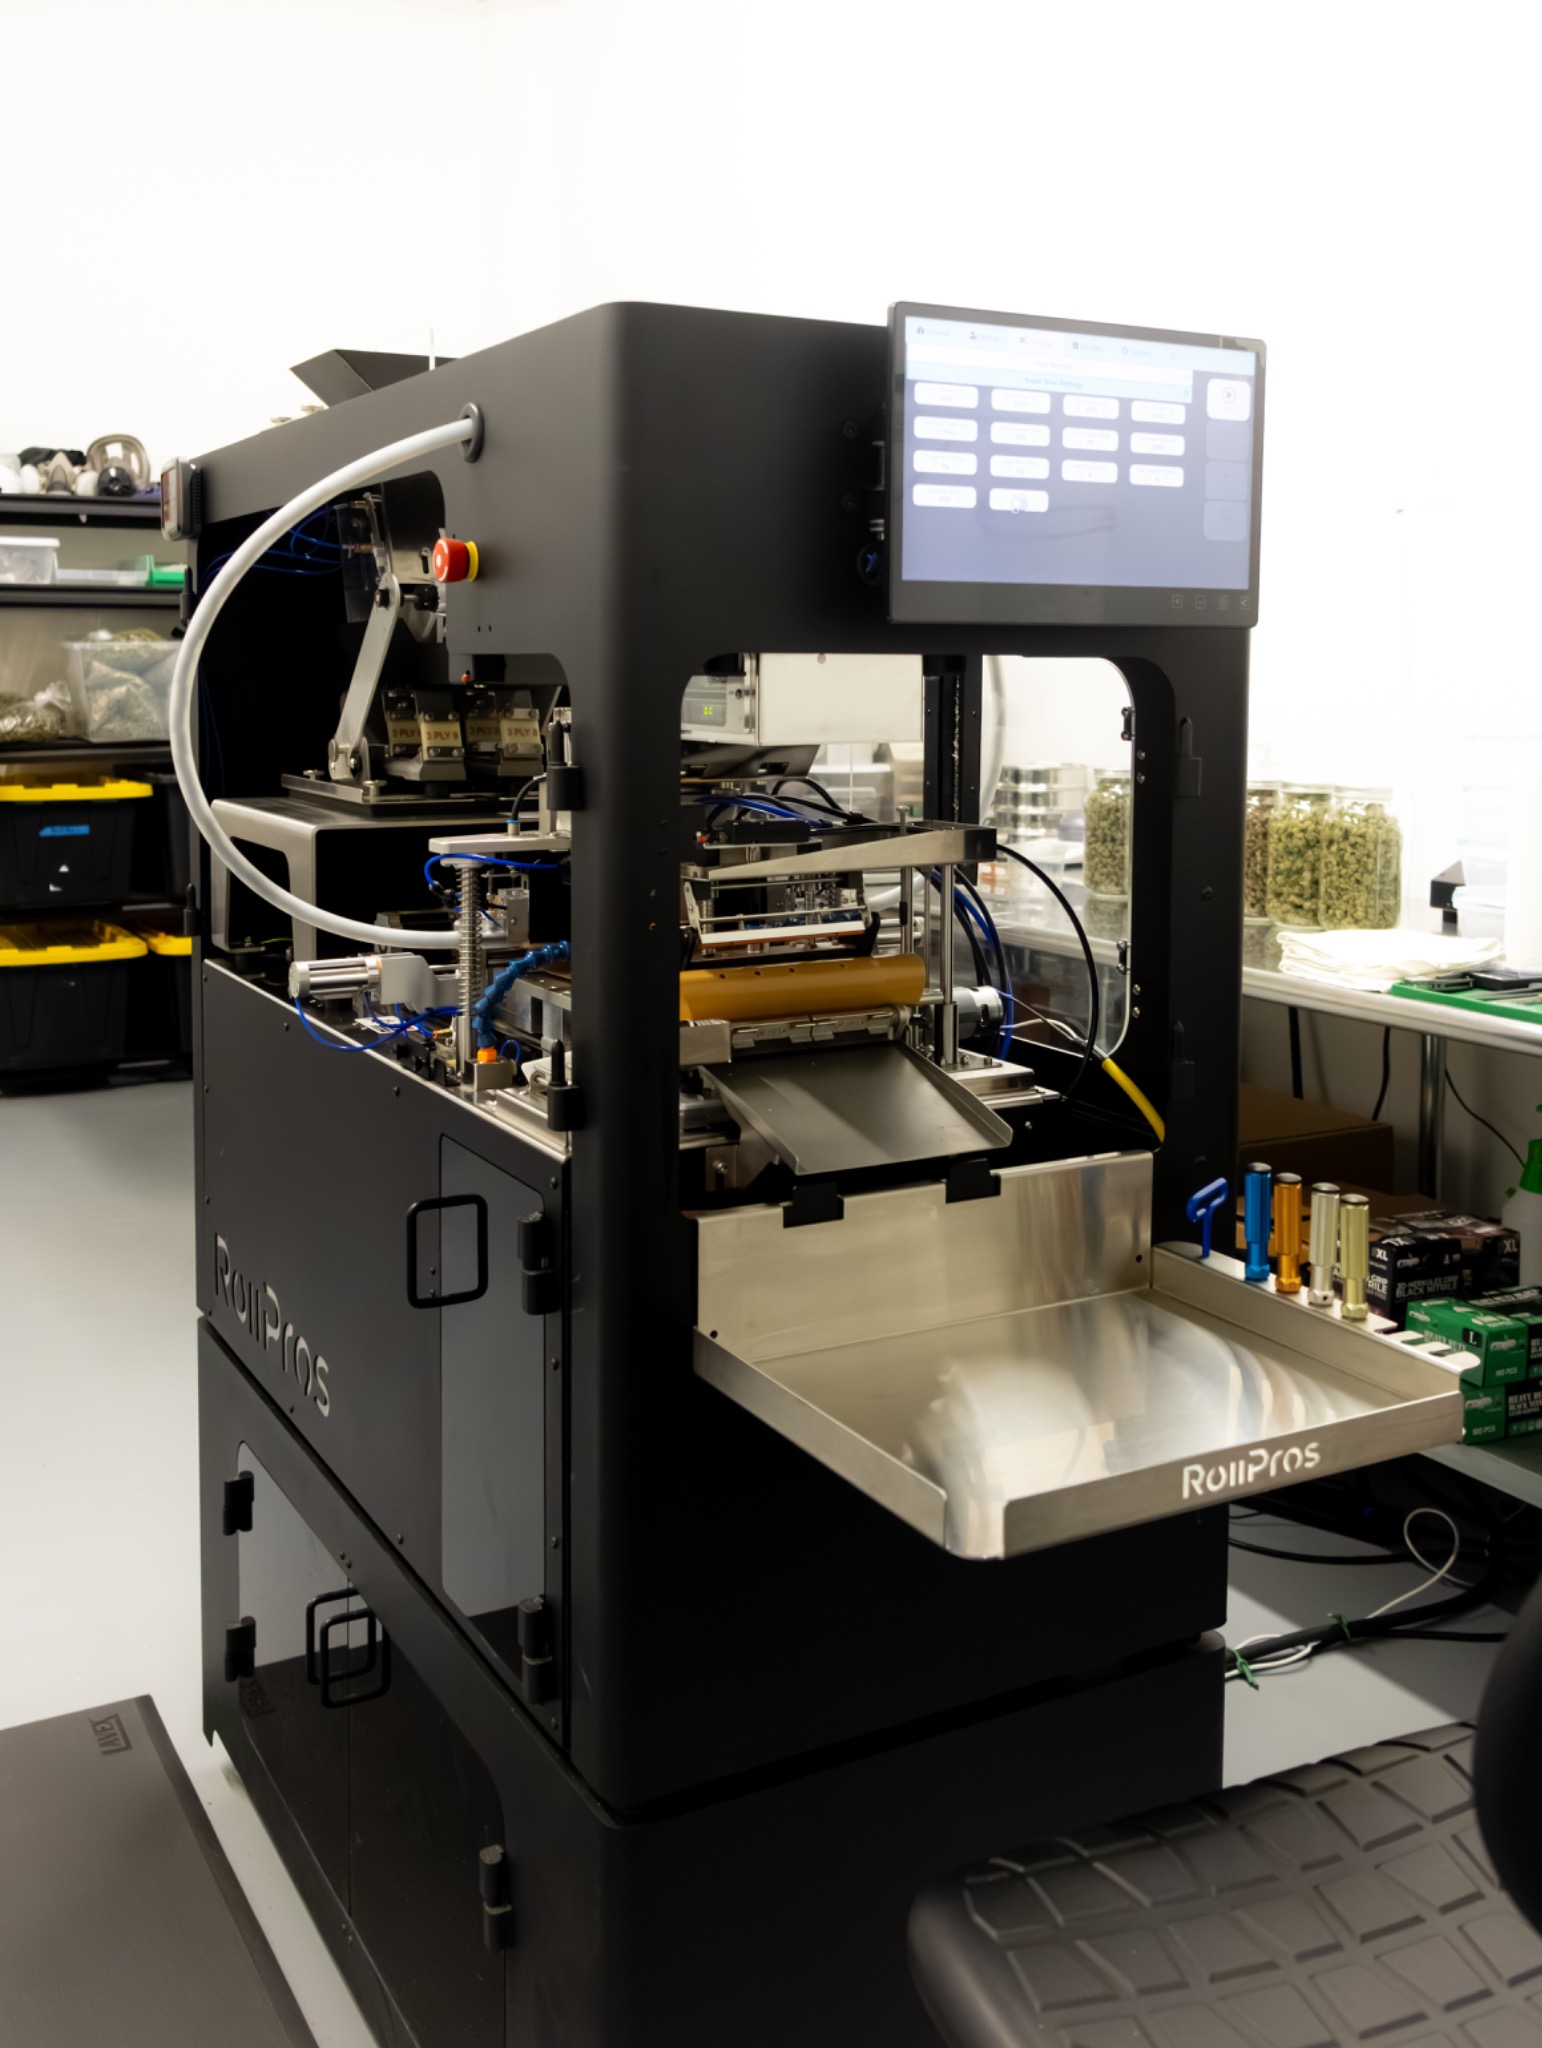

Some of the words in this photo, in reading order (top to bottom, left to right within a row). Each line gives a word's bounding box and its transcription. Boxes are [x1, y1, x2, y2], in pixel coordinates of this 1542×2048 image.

[1059, 379, 1083, 389] Settings
[215, 1232, 330, 1417] RollPros
[1469, 1331, 1477, 1345] L
[1182, 1442, 1321, 1499] RollPros
